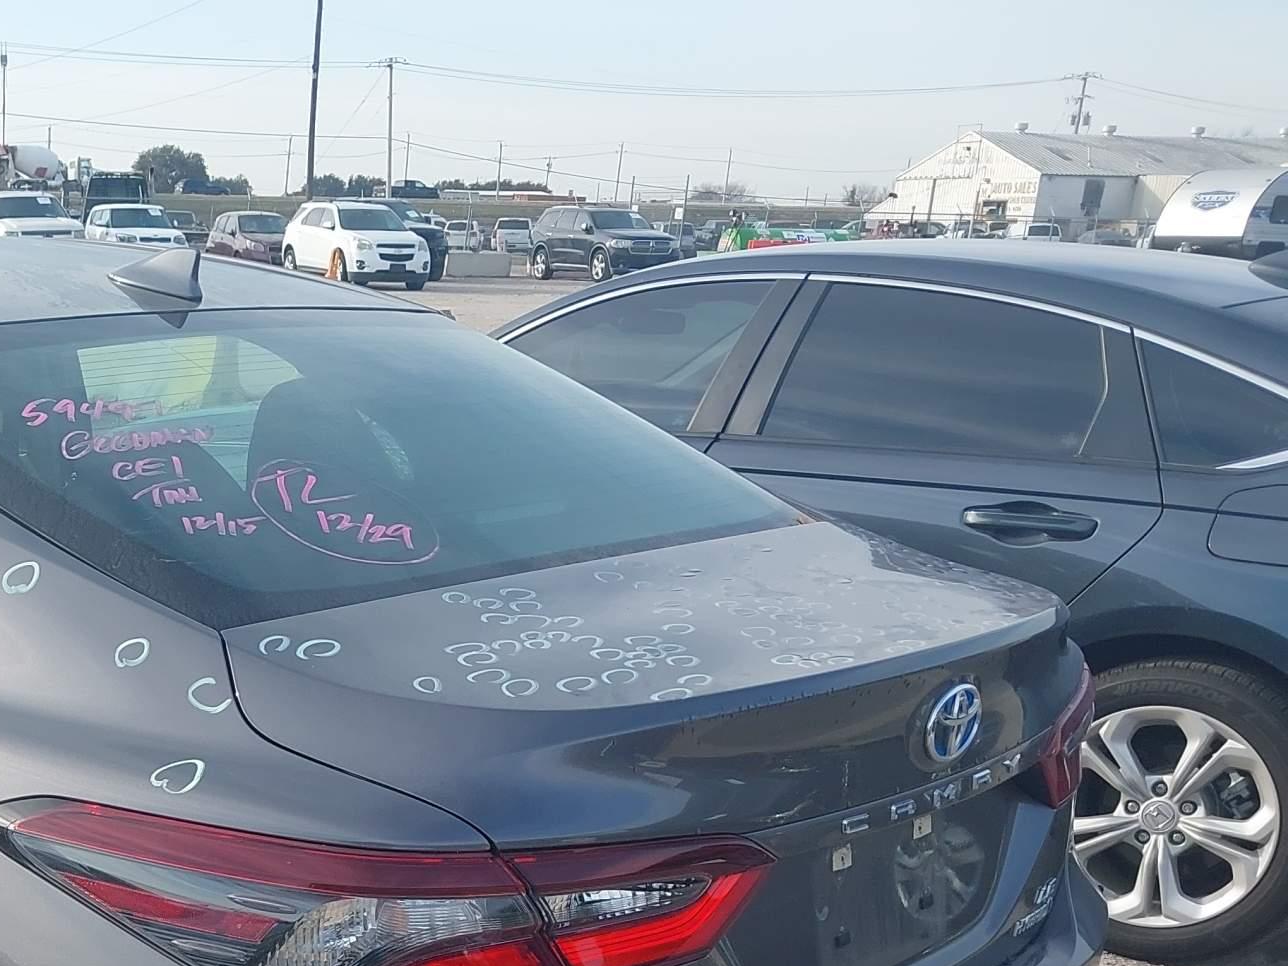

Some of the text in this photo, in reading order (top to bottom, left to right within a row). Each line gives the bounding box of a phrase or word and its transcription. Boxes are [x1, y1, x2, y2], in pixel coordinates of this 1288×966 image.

[992, 182, 1038, 194] AUTO SALES
[181, 511, 267, 537] 12/15
[316, 510, 414, 550] 12/29
[842, 753, 1022, 834] CAMRY
